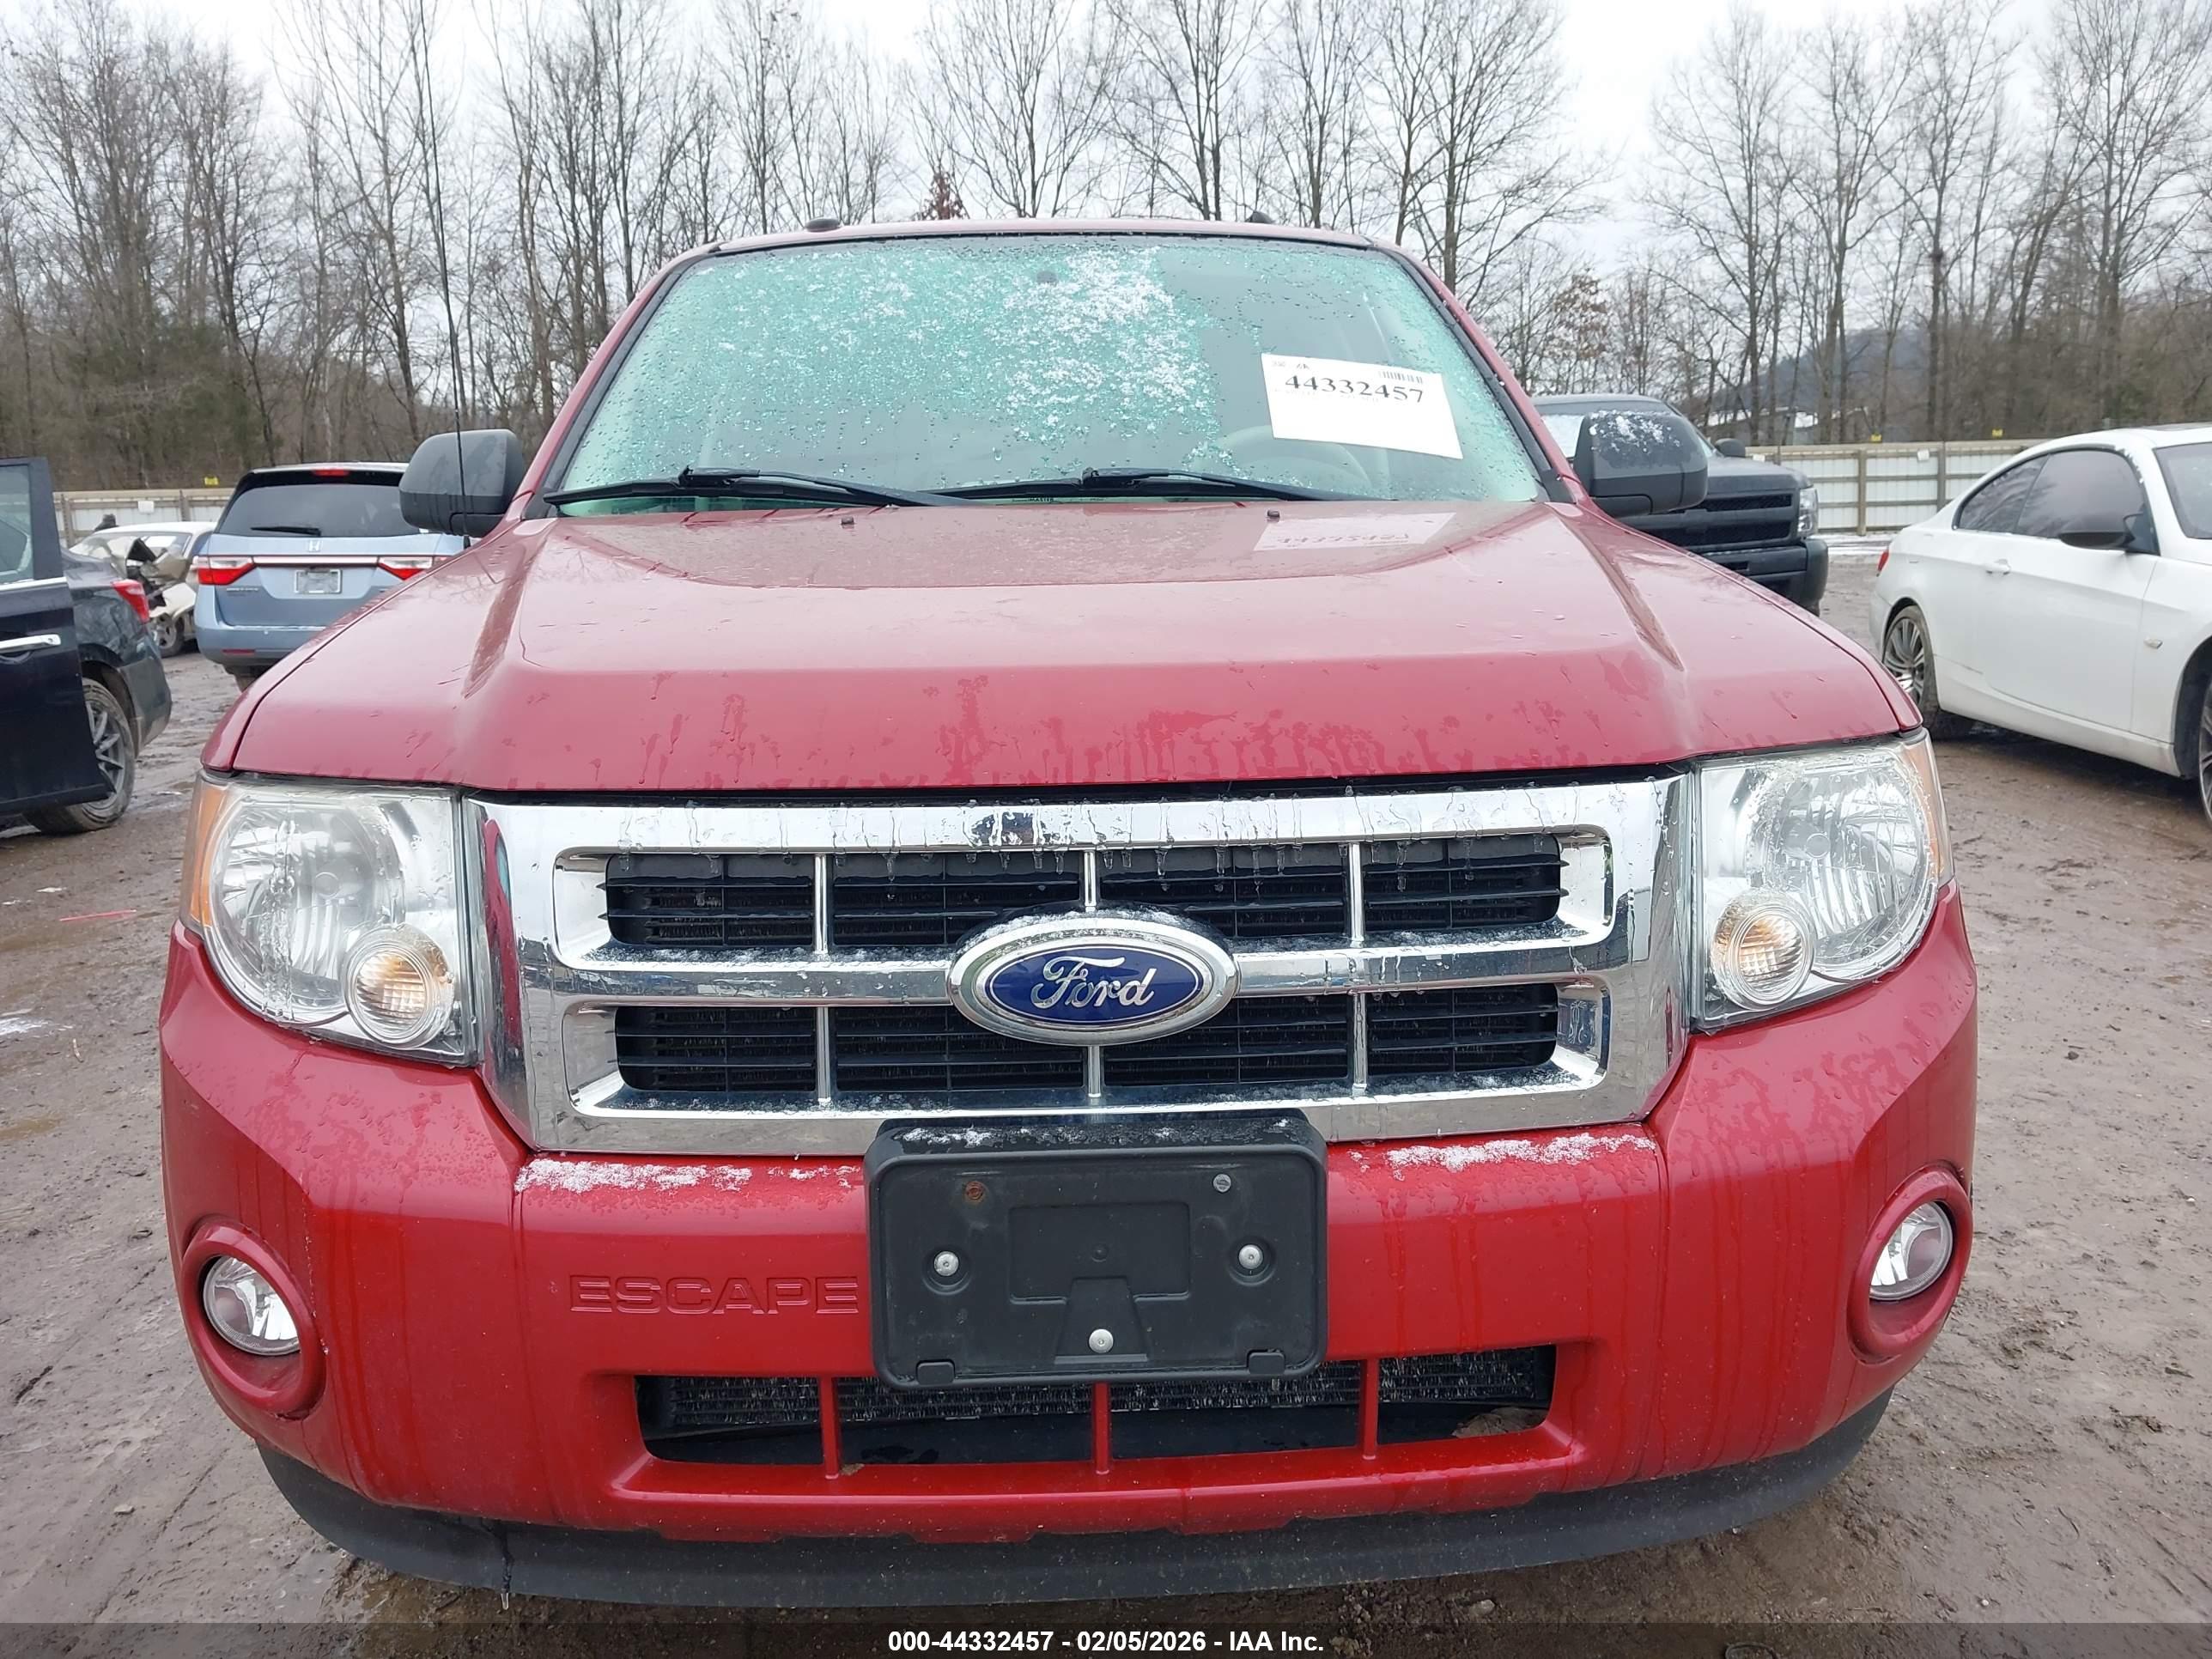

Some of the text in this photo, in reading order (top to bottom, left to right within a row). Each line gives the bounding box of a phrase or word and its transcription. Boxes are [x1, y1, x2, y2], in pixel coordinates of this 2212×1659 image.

[1285, 374, 1424, 404] 44332457
[1030, 956, 1158, 1009] Ford
[570, 1275, 859, 1315] ESCAPE
